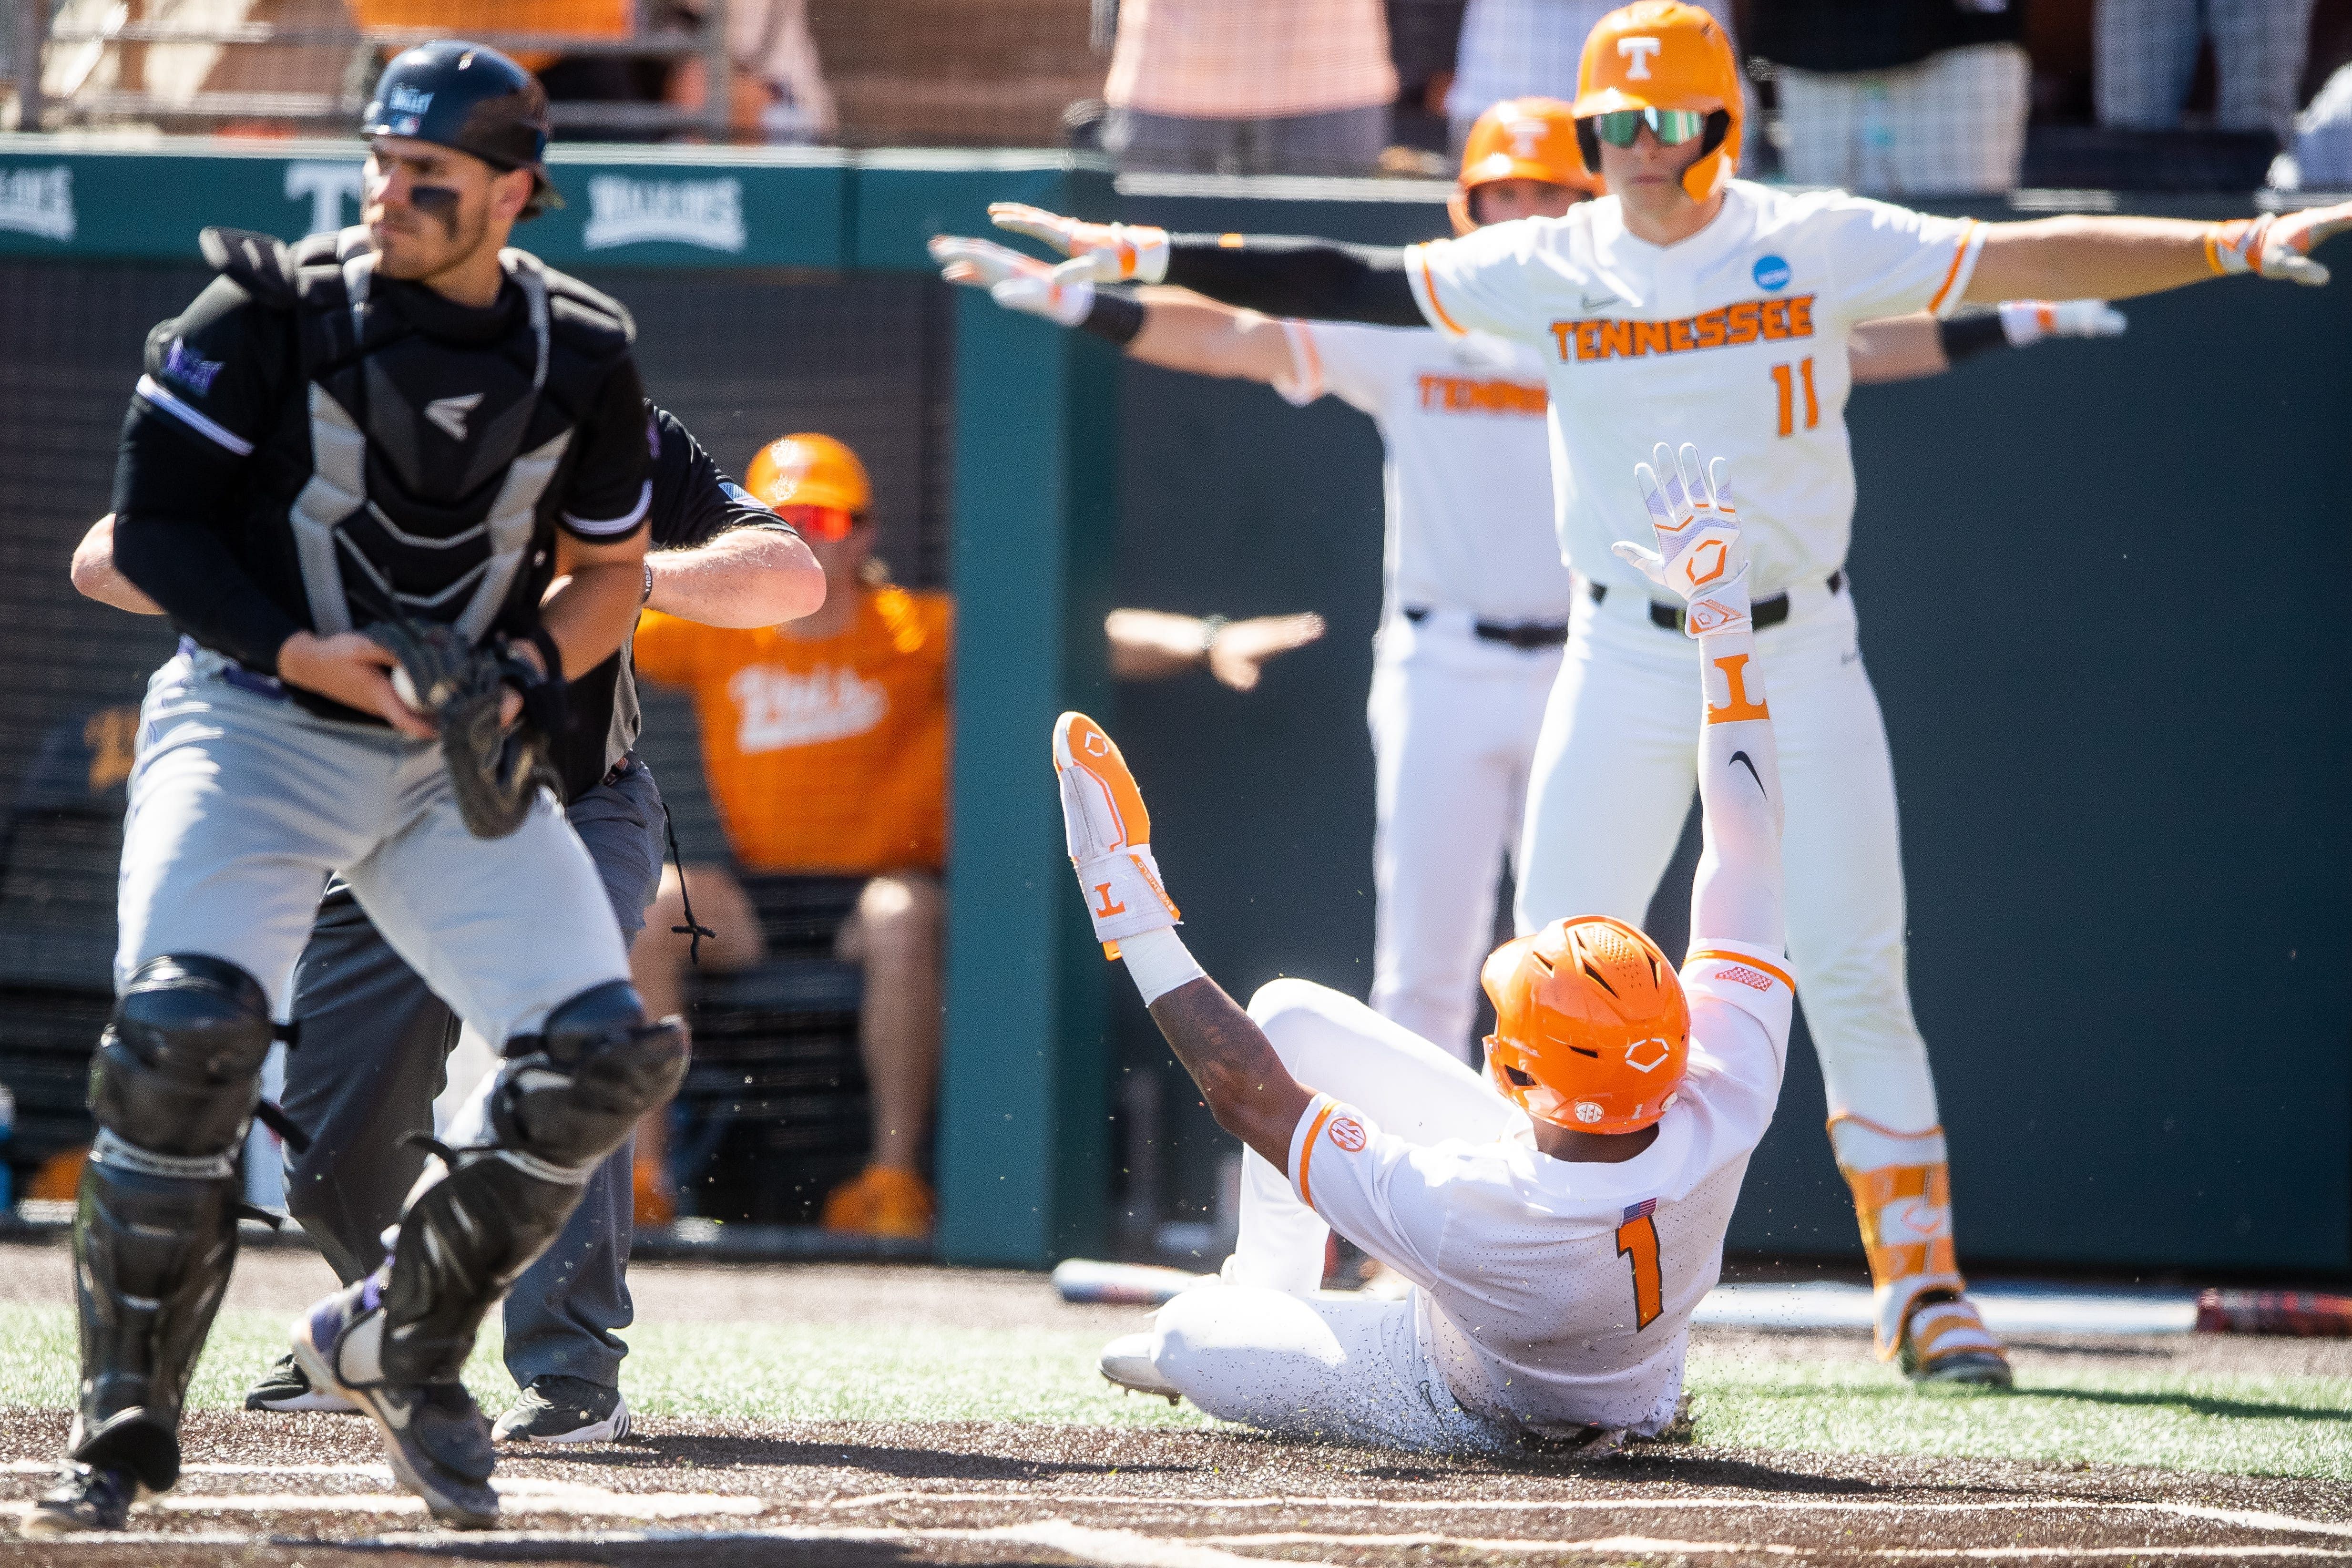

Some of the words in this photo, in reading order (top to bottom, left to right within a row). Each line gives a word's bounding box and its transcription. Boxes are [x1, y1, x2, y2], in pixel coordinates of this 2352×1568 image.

[1616, 37, 1661, 81] T
[1551, 294, 1815, 363] TENNESSEE
[1771, 355, 1820, 437] 11
[1708, 653, 1770, 726] T
[1094, 882, 1126, 919] T
[1575, 1103, 1603, 1123] SEC
[1631, 1104, 1643, 1119] 1
[1330, 1119, 1365, 1149] SEC
[1615, 1214, 1664, 1333] 1
